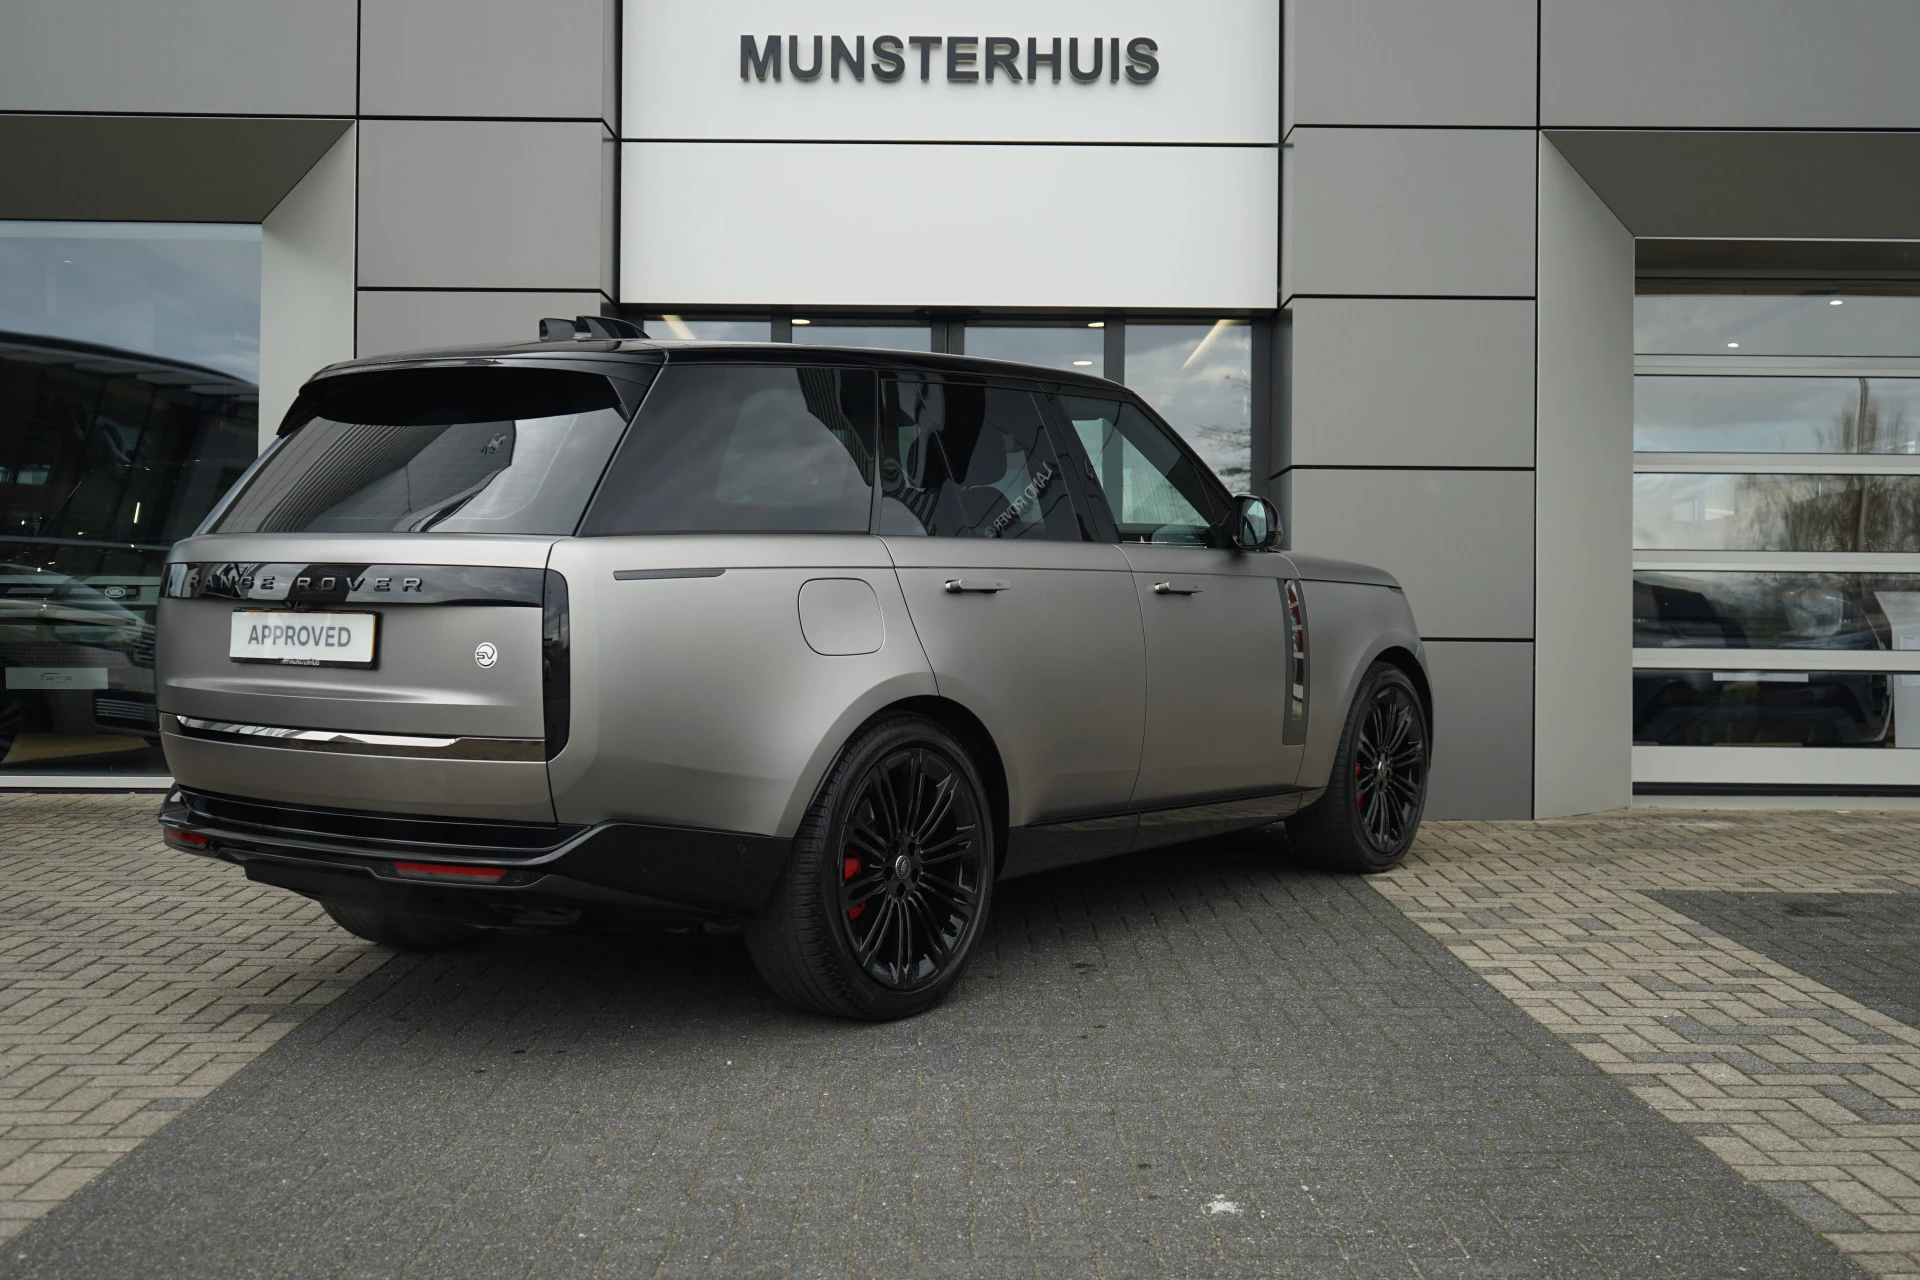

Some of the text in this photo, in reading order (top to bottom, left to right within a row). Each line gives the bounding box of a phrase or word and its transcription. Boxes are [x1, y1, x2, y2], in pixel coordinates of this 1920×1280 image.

[740, 35, 1160, 82] MUNSTERHUIS
[190, 576, 423, 593] RANGE ROVER
[248, 625, 352, 648] APPROVED
